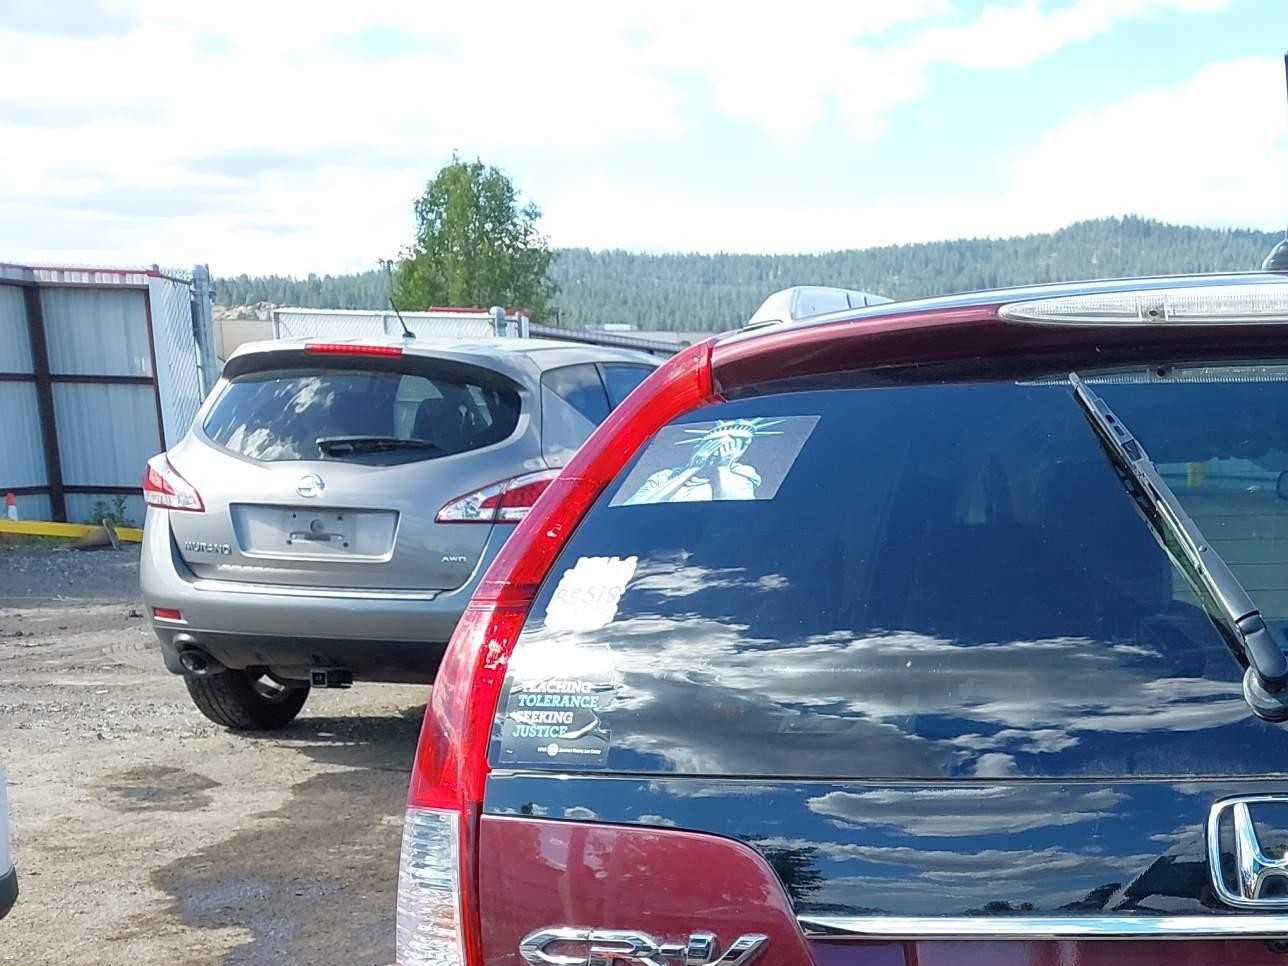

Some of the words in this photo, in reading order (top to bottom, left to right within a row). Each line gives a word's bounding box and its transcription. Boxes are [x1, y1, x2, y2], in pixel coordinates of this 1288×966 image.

[518, 694, 600, 710] TOLERANCE
[516, 710, 574, 724] SEEKING
[512, 724, 569, 738] JUSTICE
